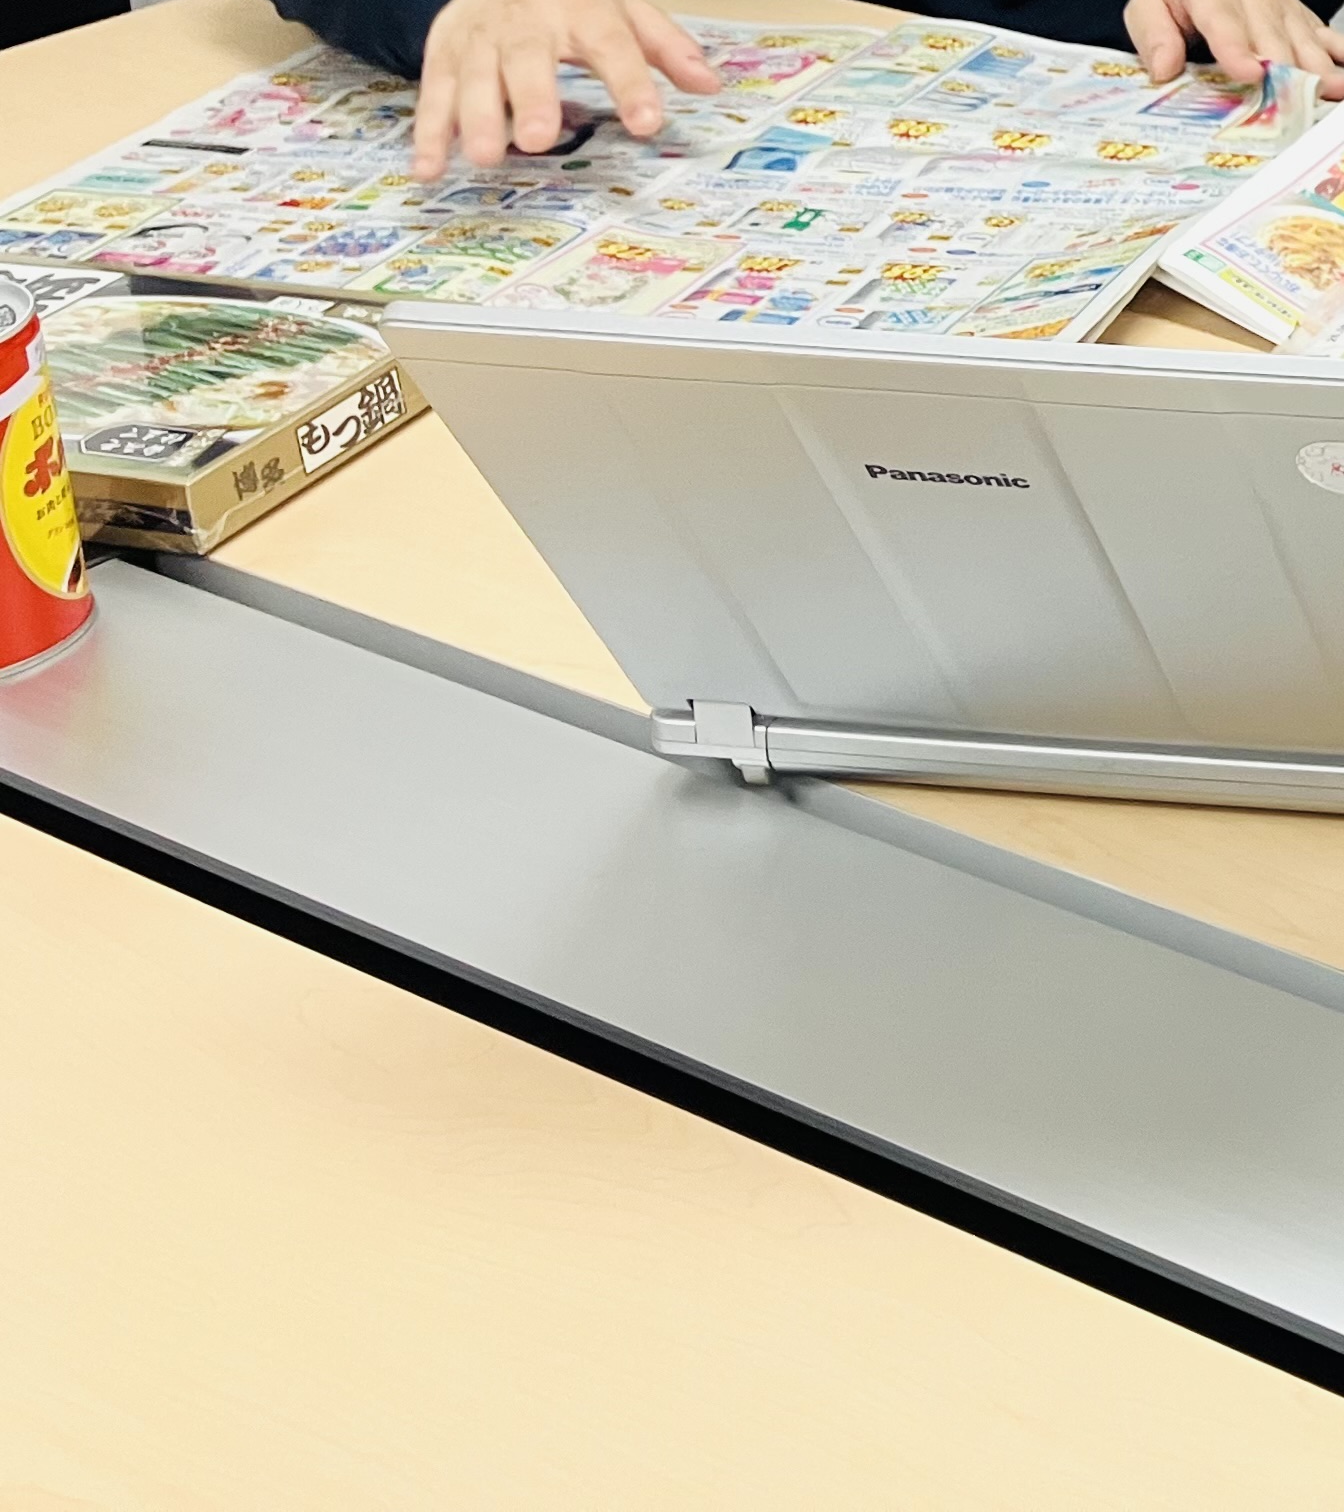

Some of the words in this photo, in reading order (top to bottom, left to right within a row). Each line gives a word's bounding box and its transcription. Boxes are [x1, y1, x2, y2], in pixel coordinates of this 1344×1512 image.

[301, 368, 405, 456] もつ鍋
[864, 463, 1031, 489] Panasonic
